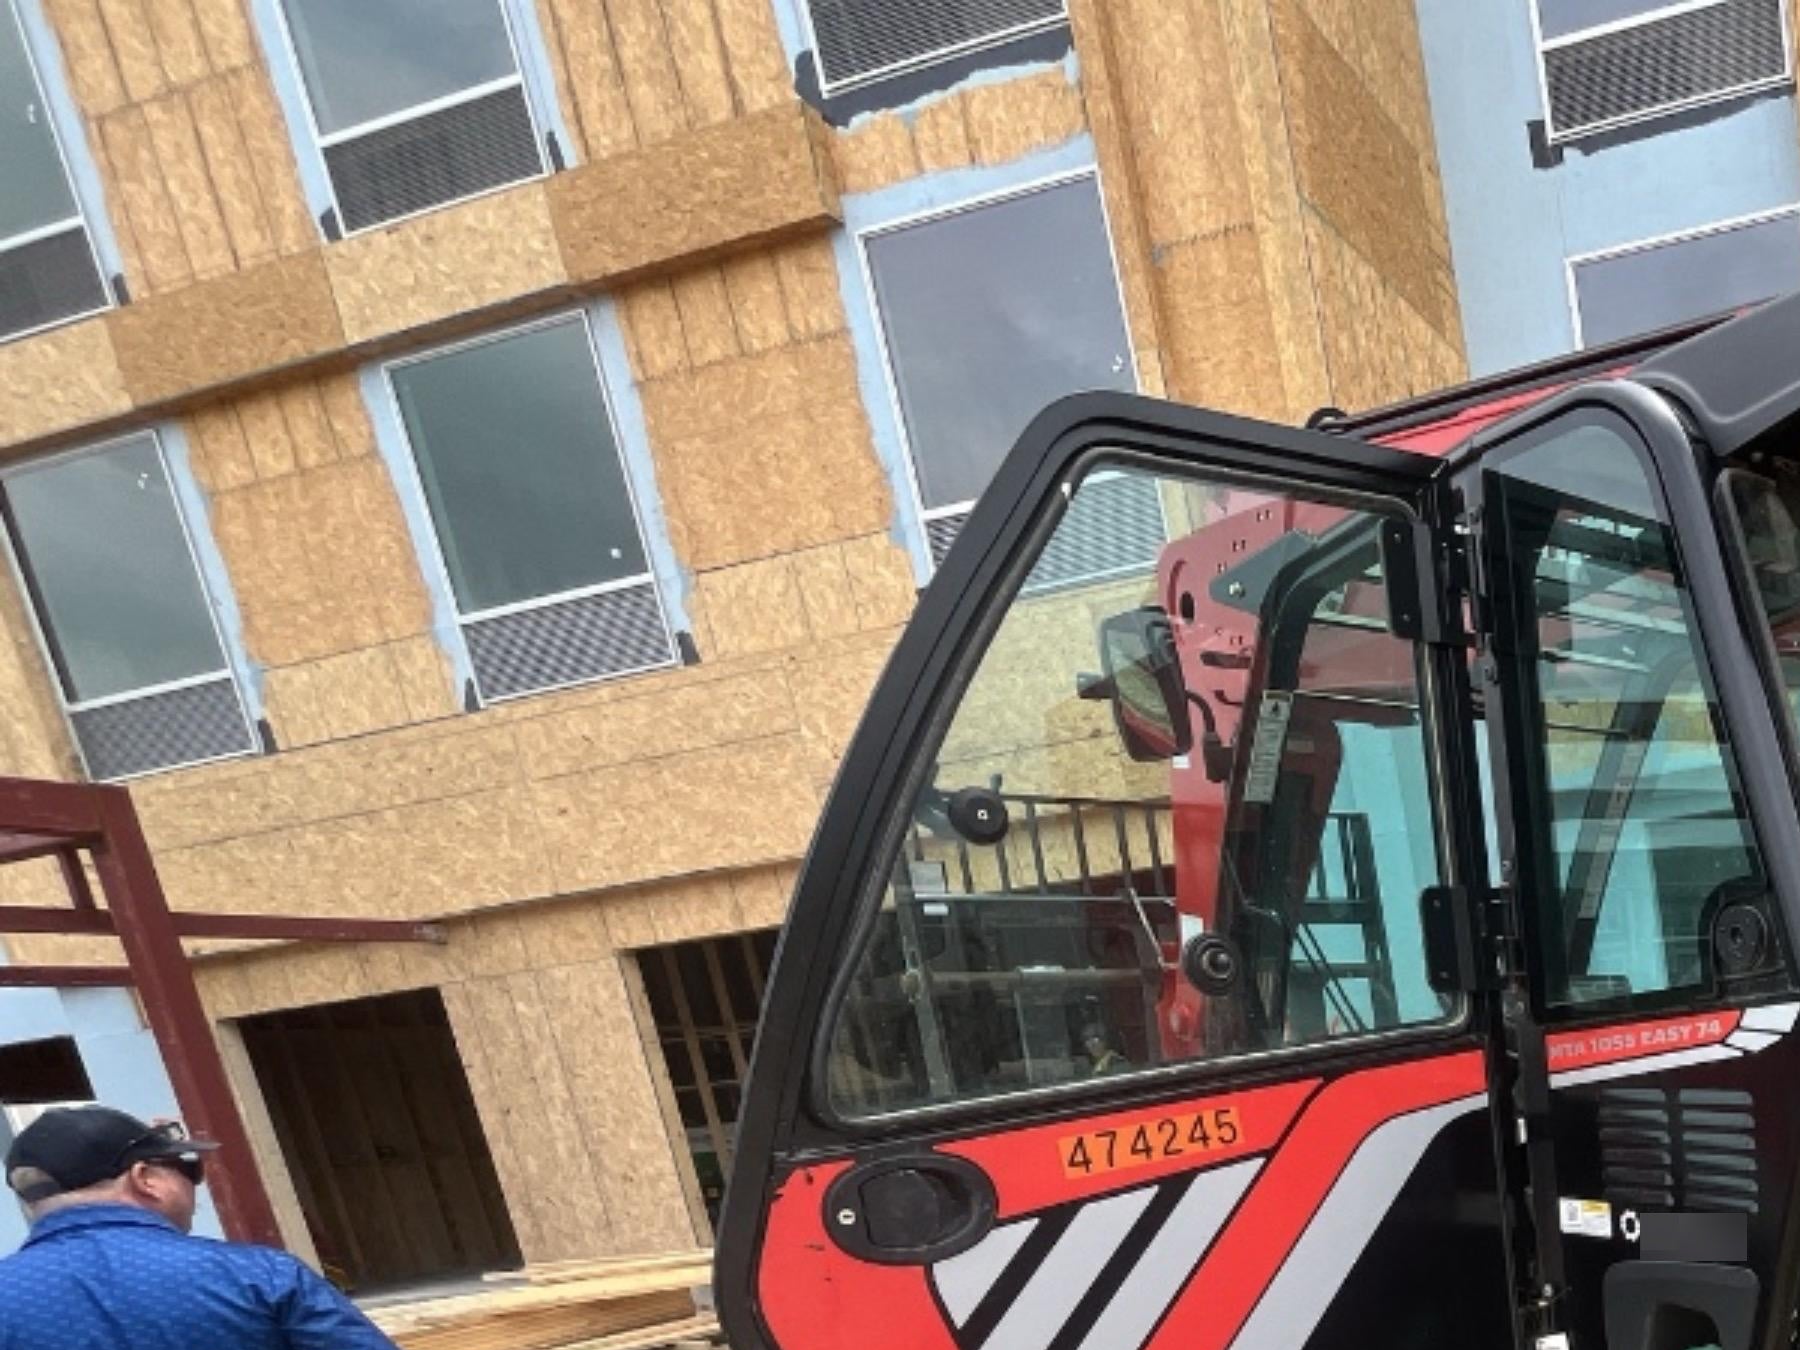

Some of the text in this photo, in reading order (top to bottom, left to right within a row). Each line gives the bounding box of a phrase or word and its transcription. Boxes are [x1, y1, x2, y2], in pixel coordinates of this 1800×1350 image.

[1640, 1021, 1692, 1046] EASY
[1695, 1018, 1722, 1038] 74
[1067, 1109, 1238, 1174] 474245
